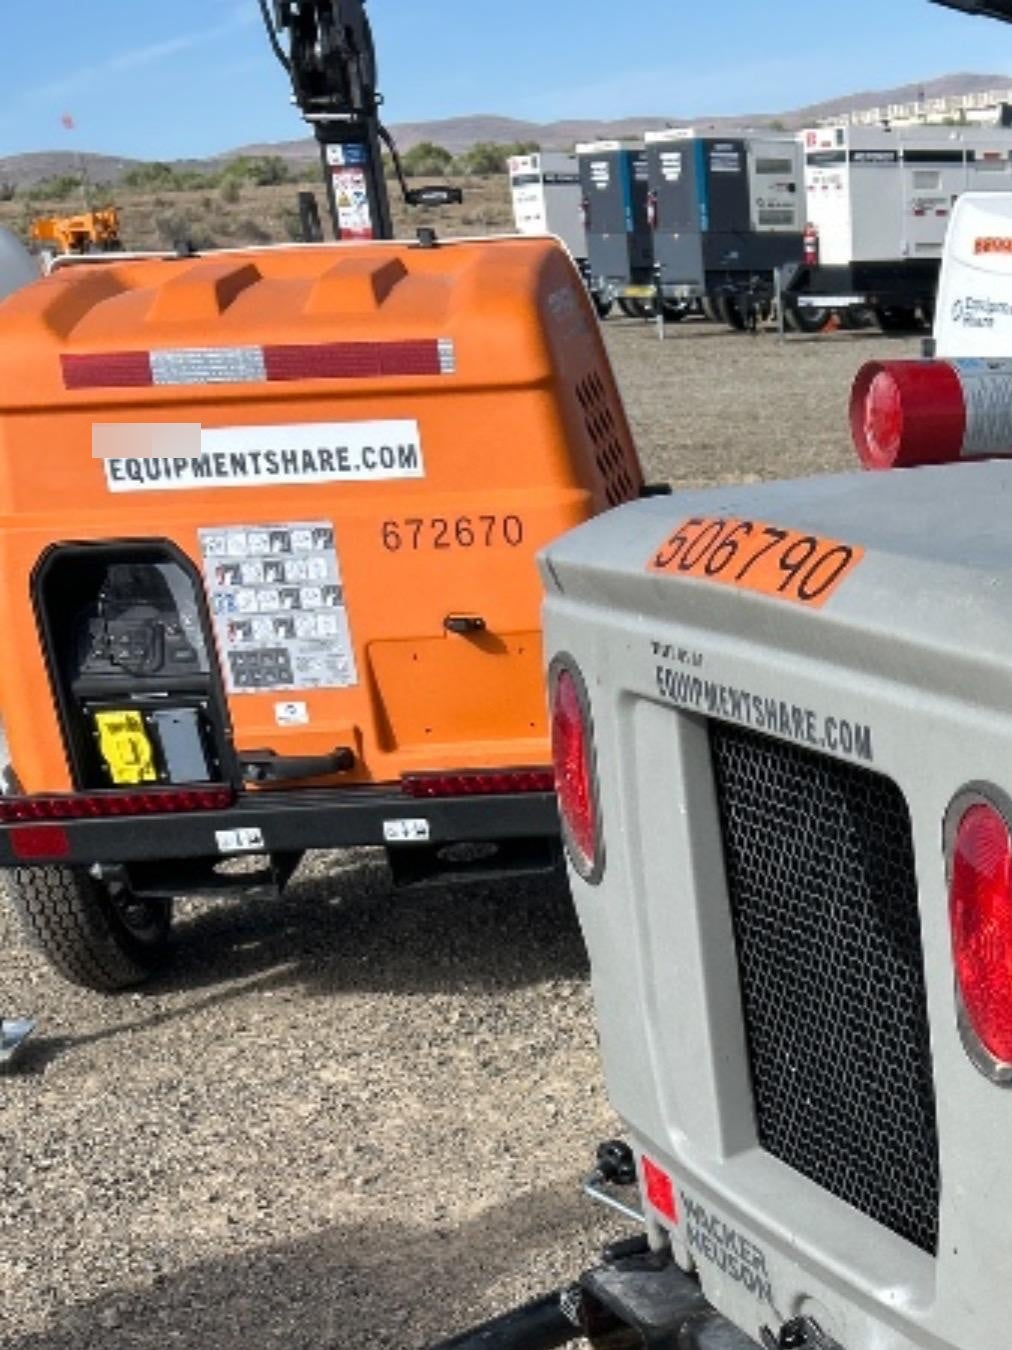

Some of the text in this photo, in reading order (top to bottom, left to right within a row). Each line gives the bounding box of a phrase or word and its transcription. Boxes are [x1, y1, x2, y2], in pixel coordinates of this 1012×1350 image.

[109, 445, 418, 483] EQUIPMENTSHARE.COM
[383, 516, 523, 551] 672670
[654, 519, 853, 600] 506790
[656, 666, 873, 761] EQUIPMENTSHARE.COM
[681, 1191, 769, 1278] WACKER
